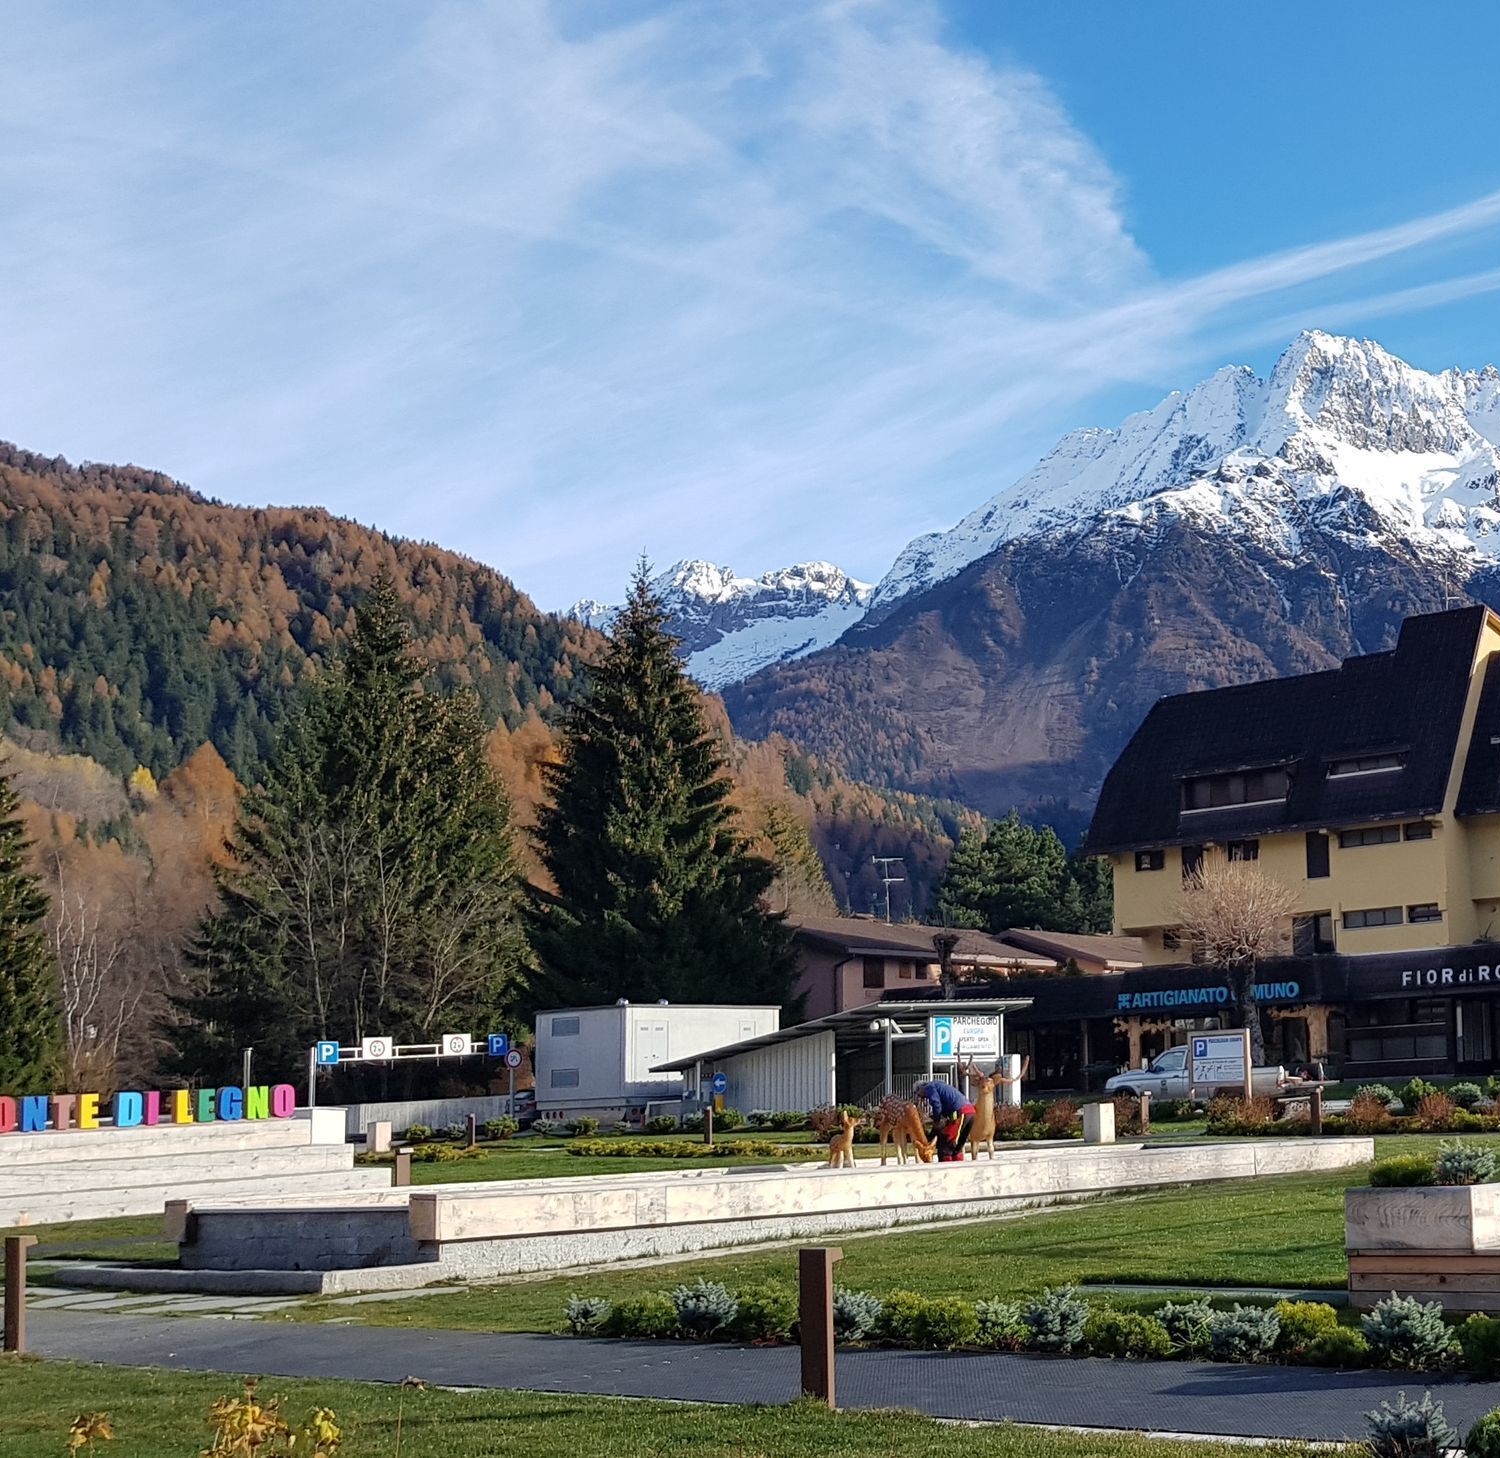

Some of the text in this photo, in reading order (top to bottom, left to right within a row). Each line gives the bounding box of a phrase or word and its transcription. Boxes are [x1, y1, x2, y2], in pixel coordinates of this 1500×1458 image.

[1402, 968, 1453, 986] FIOR
[1459, 969, 1473, 982] di
[1132, 981, 1299, 1008] ARTIGIANATO MUNO
[953, 1016, 998, 1026] PARCHEGGIO
[493, 1038, 505, 1052] P
[936, 1026, 951, 1053] P
[321, 1045, 334, 1061] P
[1196, 1041, 1205, 1056] P
[115, 1090, 160, 1128] DI
[172, 1083, 296, 1124] LEGNO
